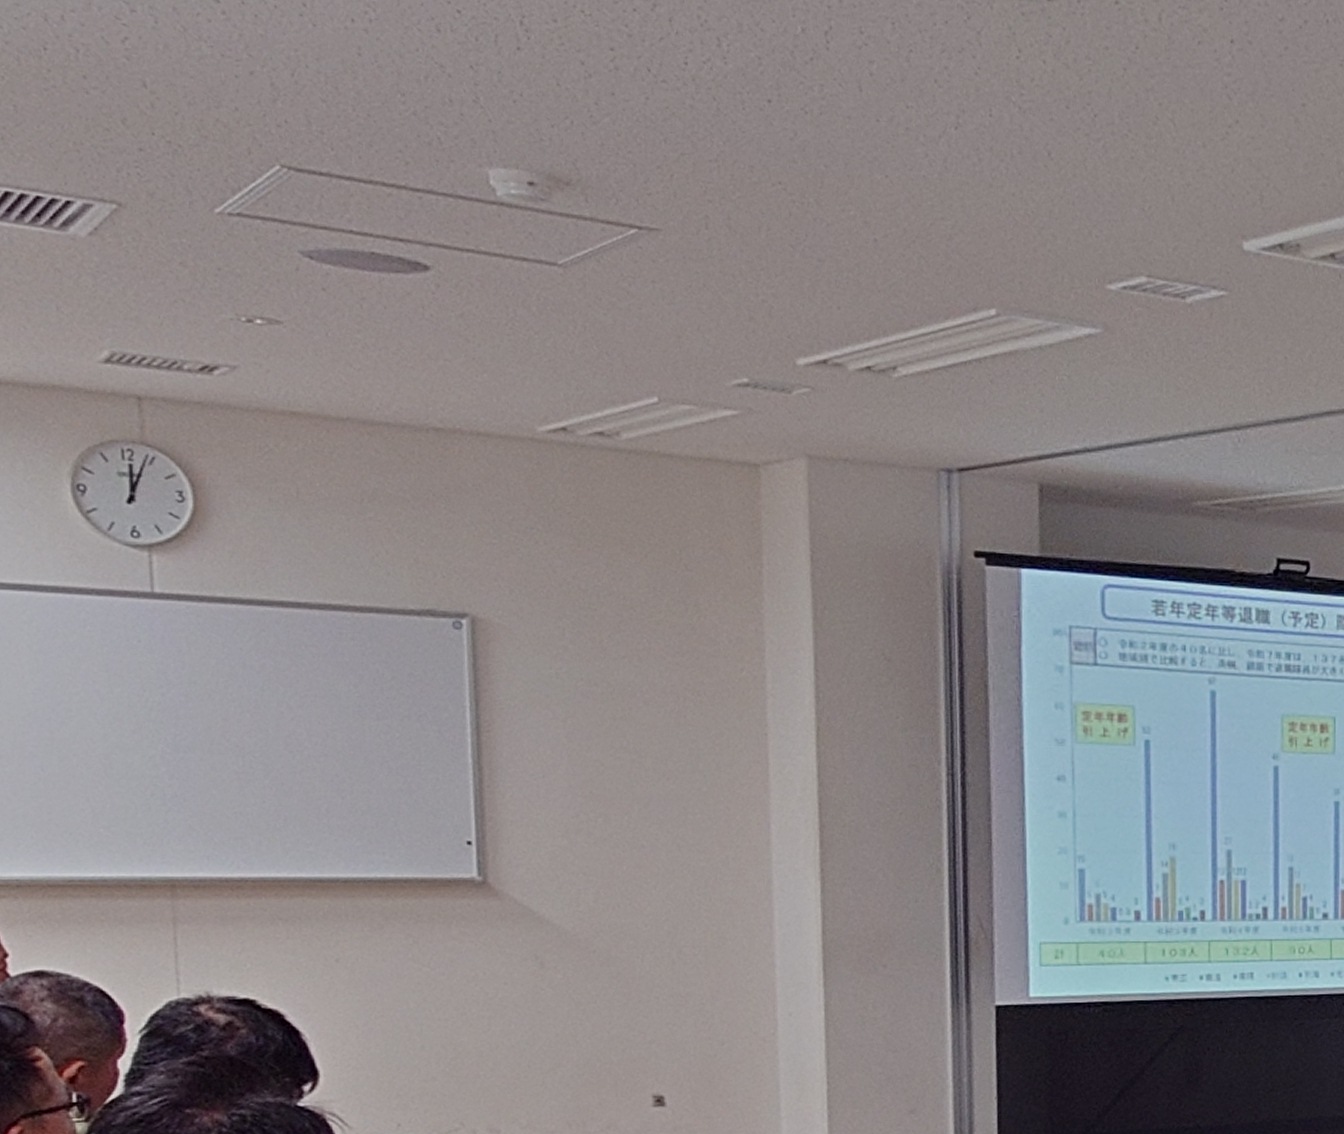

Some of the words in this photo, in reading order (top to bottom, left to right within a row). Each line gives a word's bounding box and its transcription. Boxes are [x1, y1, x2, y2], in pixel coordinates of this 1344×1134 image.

[121, 448, 134, 461] 12
[76, 483, 87, 496] 9
[175, 490, 186, 503] 3
[130, 525, 141, 539] 6
